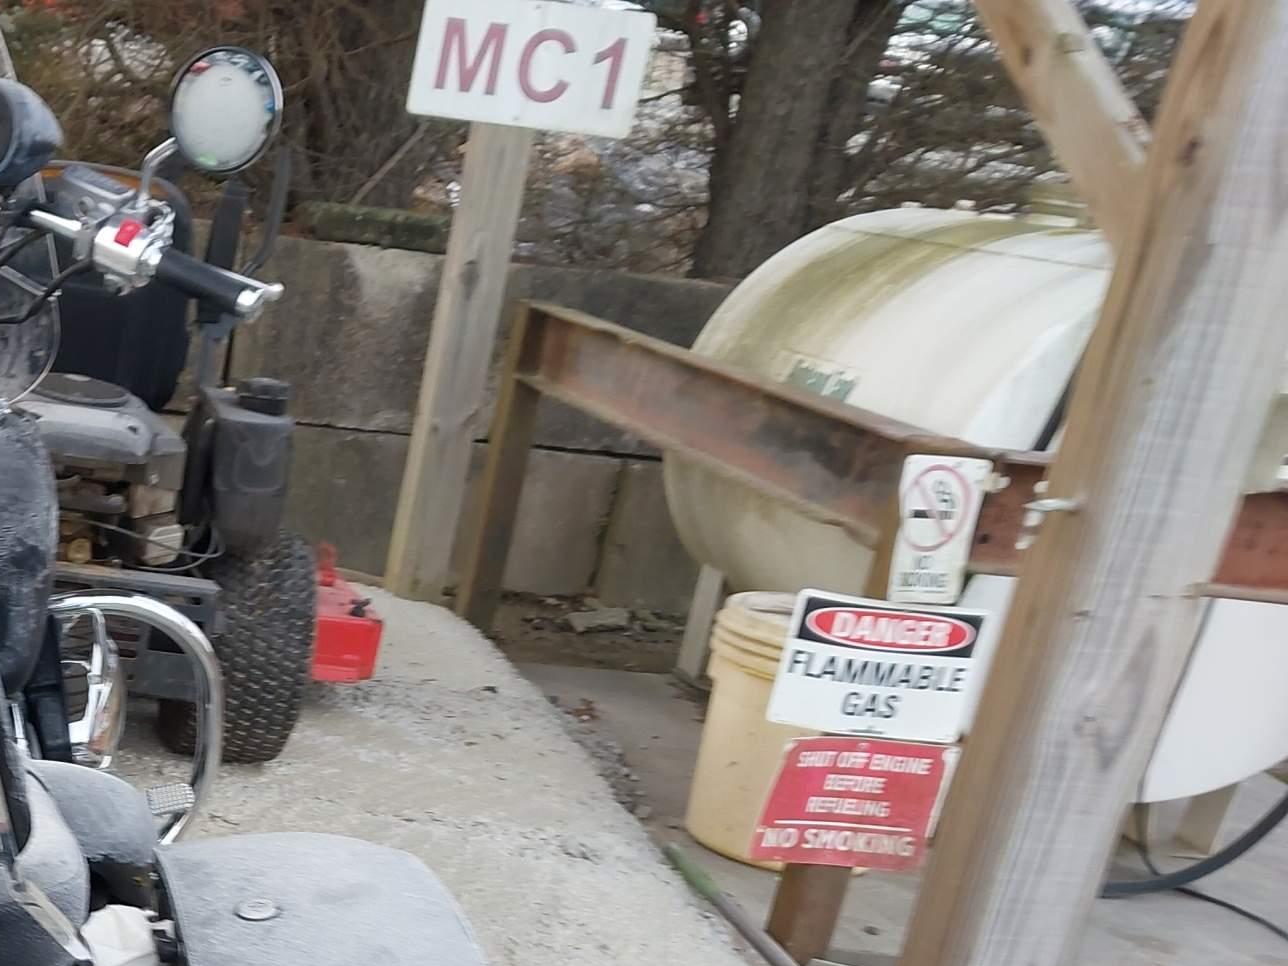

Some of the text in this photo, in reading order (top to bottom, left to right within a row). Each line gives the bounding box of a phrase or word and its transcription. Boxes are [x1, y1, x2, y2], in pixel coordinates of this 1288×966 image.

[432, 17, 629, 110] MC1
[830, 611, 954, 647] DANGER
[787, 649, 967, 692] FLAMMABLE
[841, 691, 902, 719] GAS
[796, 751, 935, 775] SHUT OFF ENGINE
[761, 827, 917, 857] NO SMOKING
